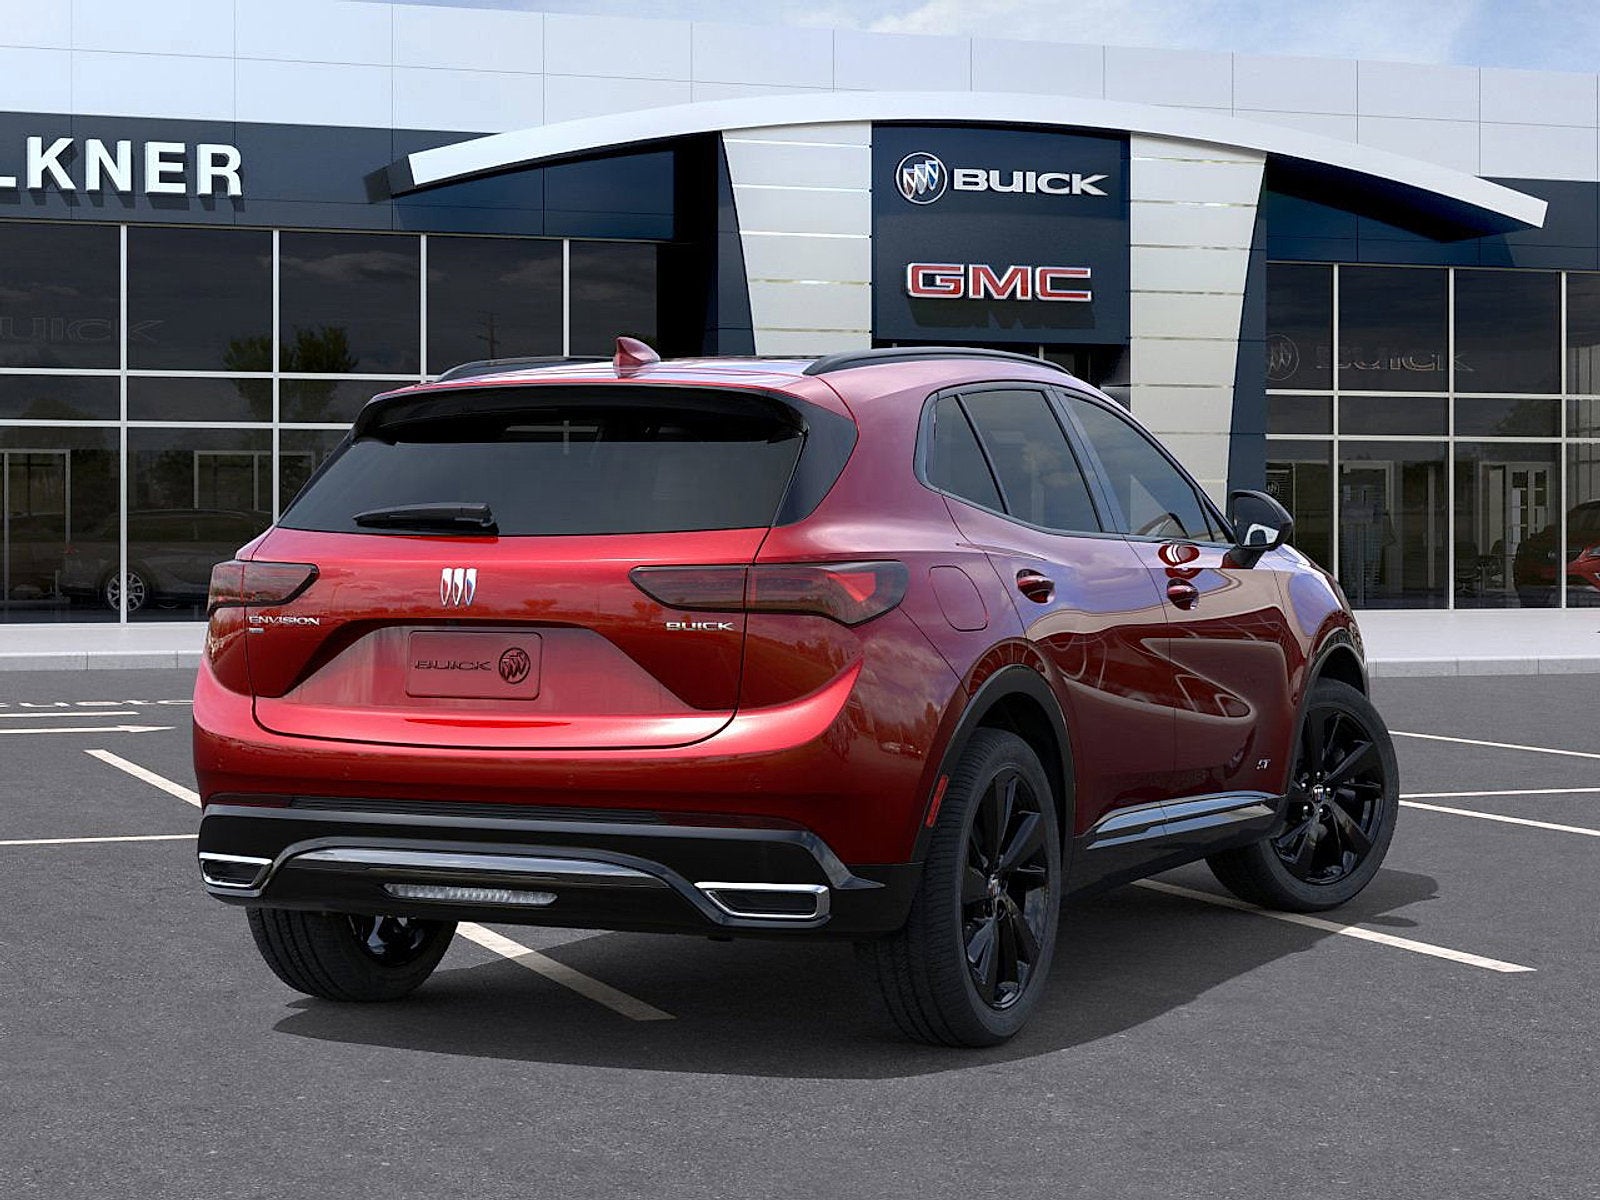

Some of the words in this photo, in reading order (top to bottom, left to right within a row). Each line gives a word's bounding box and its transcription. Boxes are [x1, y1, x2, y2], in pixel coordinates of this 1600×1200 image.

[0, 136, 243, 196] KNER
[953, 168, 1109, 196] BUICK
[907, 263, 1092, 302] GMC
[248, 616, 320, 626] ENVISION
[665, 621, 735, 631] BUICK
[414, 660, 493, 671] BUICK
